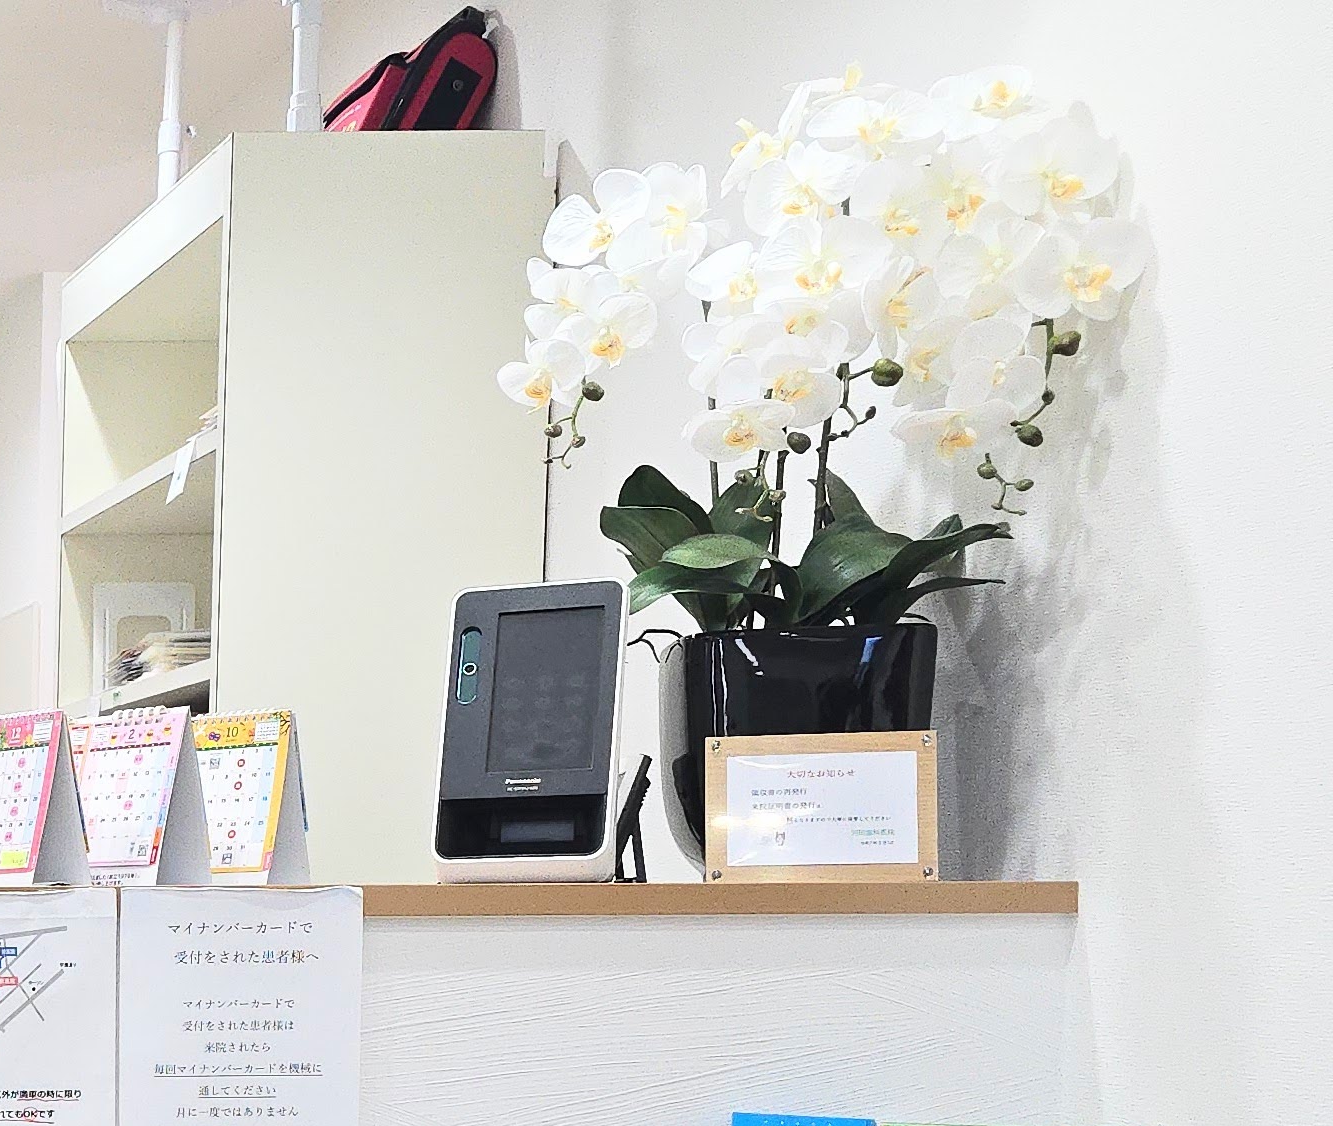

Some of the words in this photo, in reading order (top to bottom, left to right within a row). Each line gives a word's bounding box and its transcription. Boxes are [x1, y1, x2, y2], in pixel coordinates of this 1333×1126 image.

[128, 729, 135, 740] 2
[227, 727, 239, 738] 10
[787, 769, 856, 779] 大切なお知らせ
[168, 922, 313, 935] マイナンバーカードで
[174, 950, 319, 965] 受付をされた患者様へ
[183, 998, 295, 1009] マイナンバーカードで
[183, 1020, 294, 1032] 受付をされた患者様は
[205, 1042, 271, 1053] 来院されたら
[155, 1063, 322, 1075] 毎回マイナンバーカードを機械に
[199, 1085, 276, 1096] 通してください
[176, 1106, 299, 1118] 月に一度ではありません
